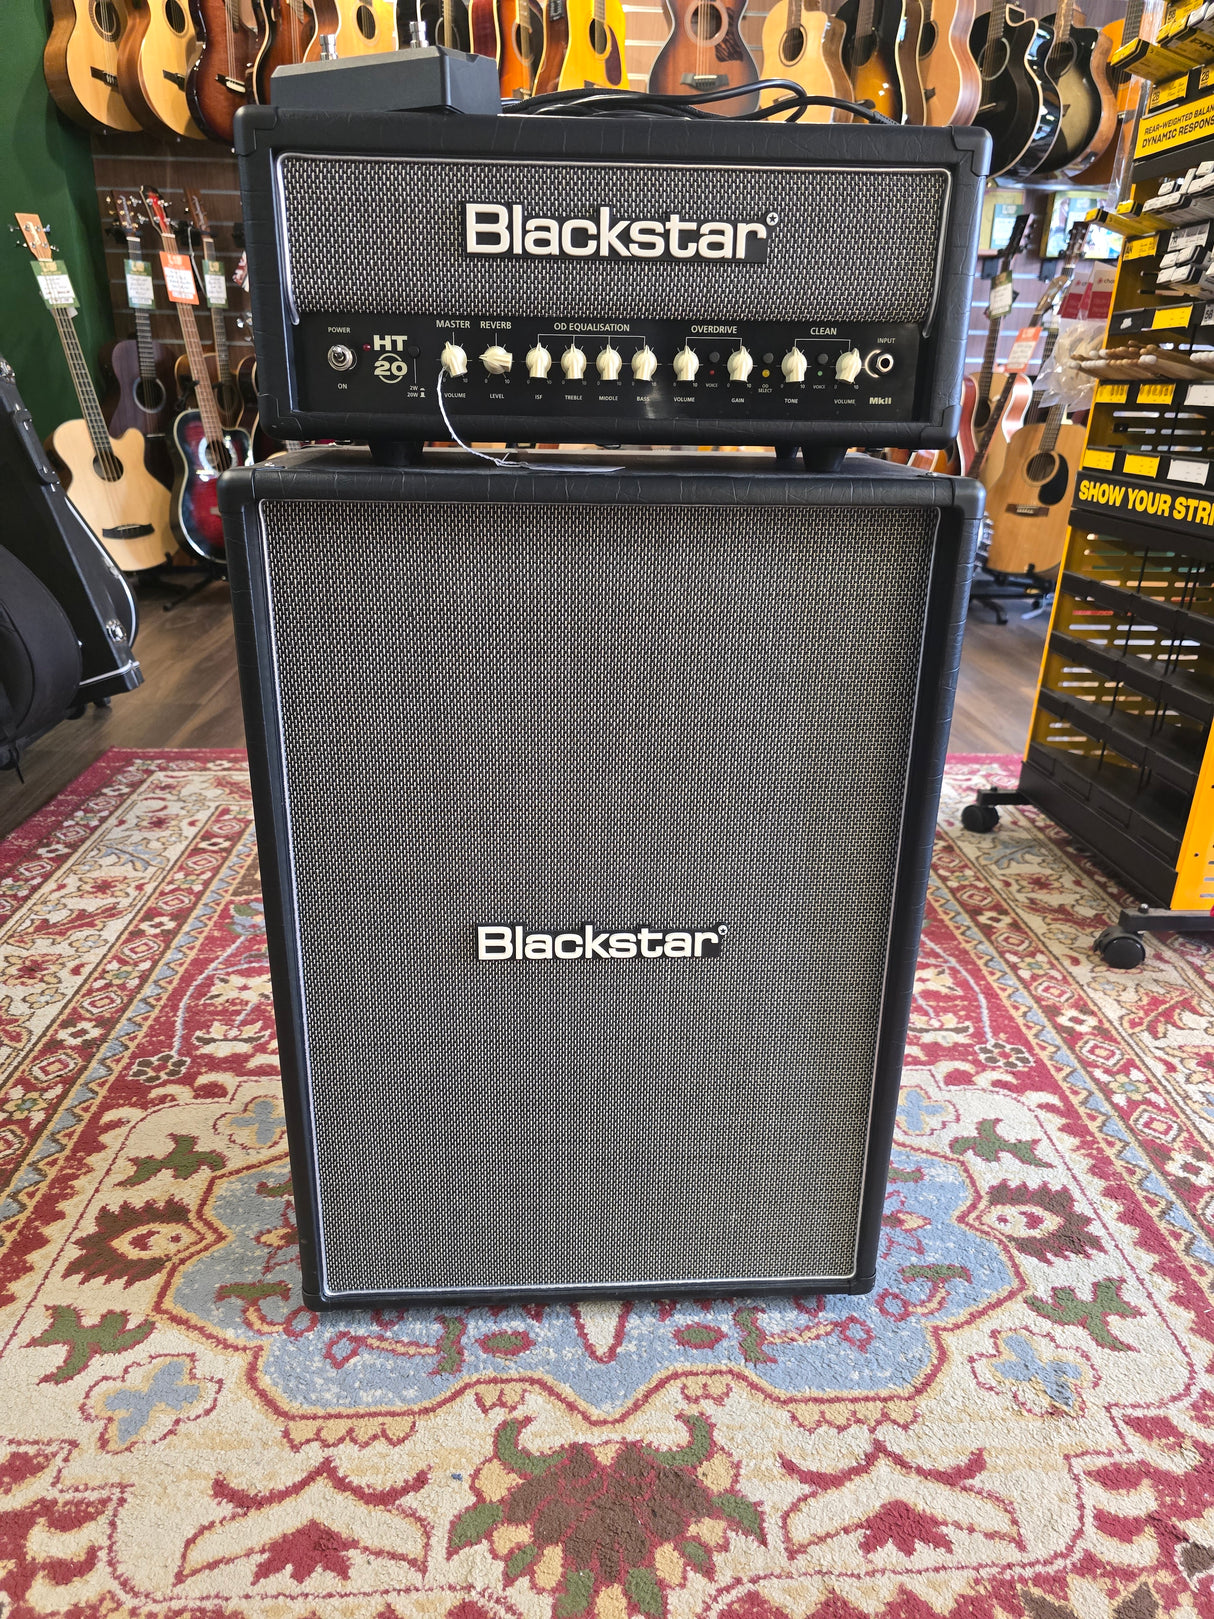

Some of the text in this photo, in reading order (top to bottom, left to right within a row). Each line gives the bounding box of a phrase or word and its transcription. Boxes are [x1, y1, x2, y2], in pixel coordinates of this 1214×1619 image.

[1145, 112, 1193, 134] REAR-WEIGHTED
[1142, 128, 1177, 148] DYNAMIC
[465, 203, 767, 259] Blackstar
[436, 320, 471, 329] MASTER
[480, 321, 512, 329] REVERB
[553, 322, 630, 332] OD EQUALISATION
[691, 325, 738, 334] OVERDRIVE
[810, 327, 837, 335] CLEAN
[373, 335, 408, 351] HT
[374, 360, 408, 376] 20
[869, 397, 892, 405] MkII
[1079, 480, 1125, 507] SHOW
[1127, 488, 1171, 517] YOUR
[477, 924, 719, 961] Blackstar
